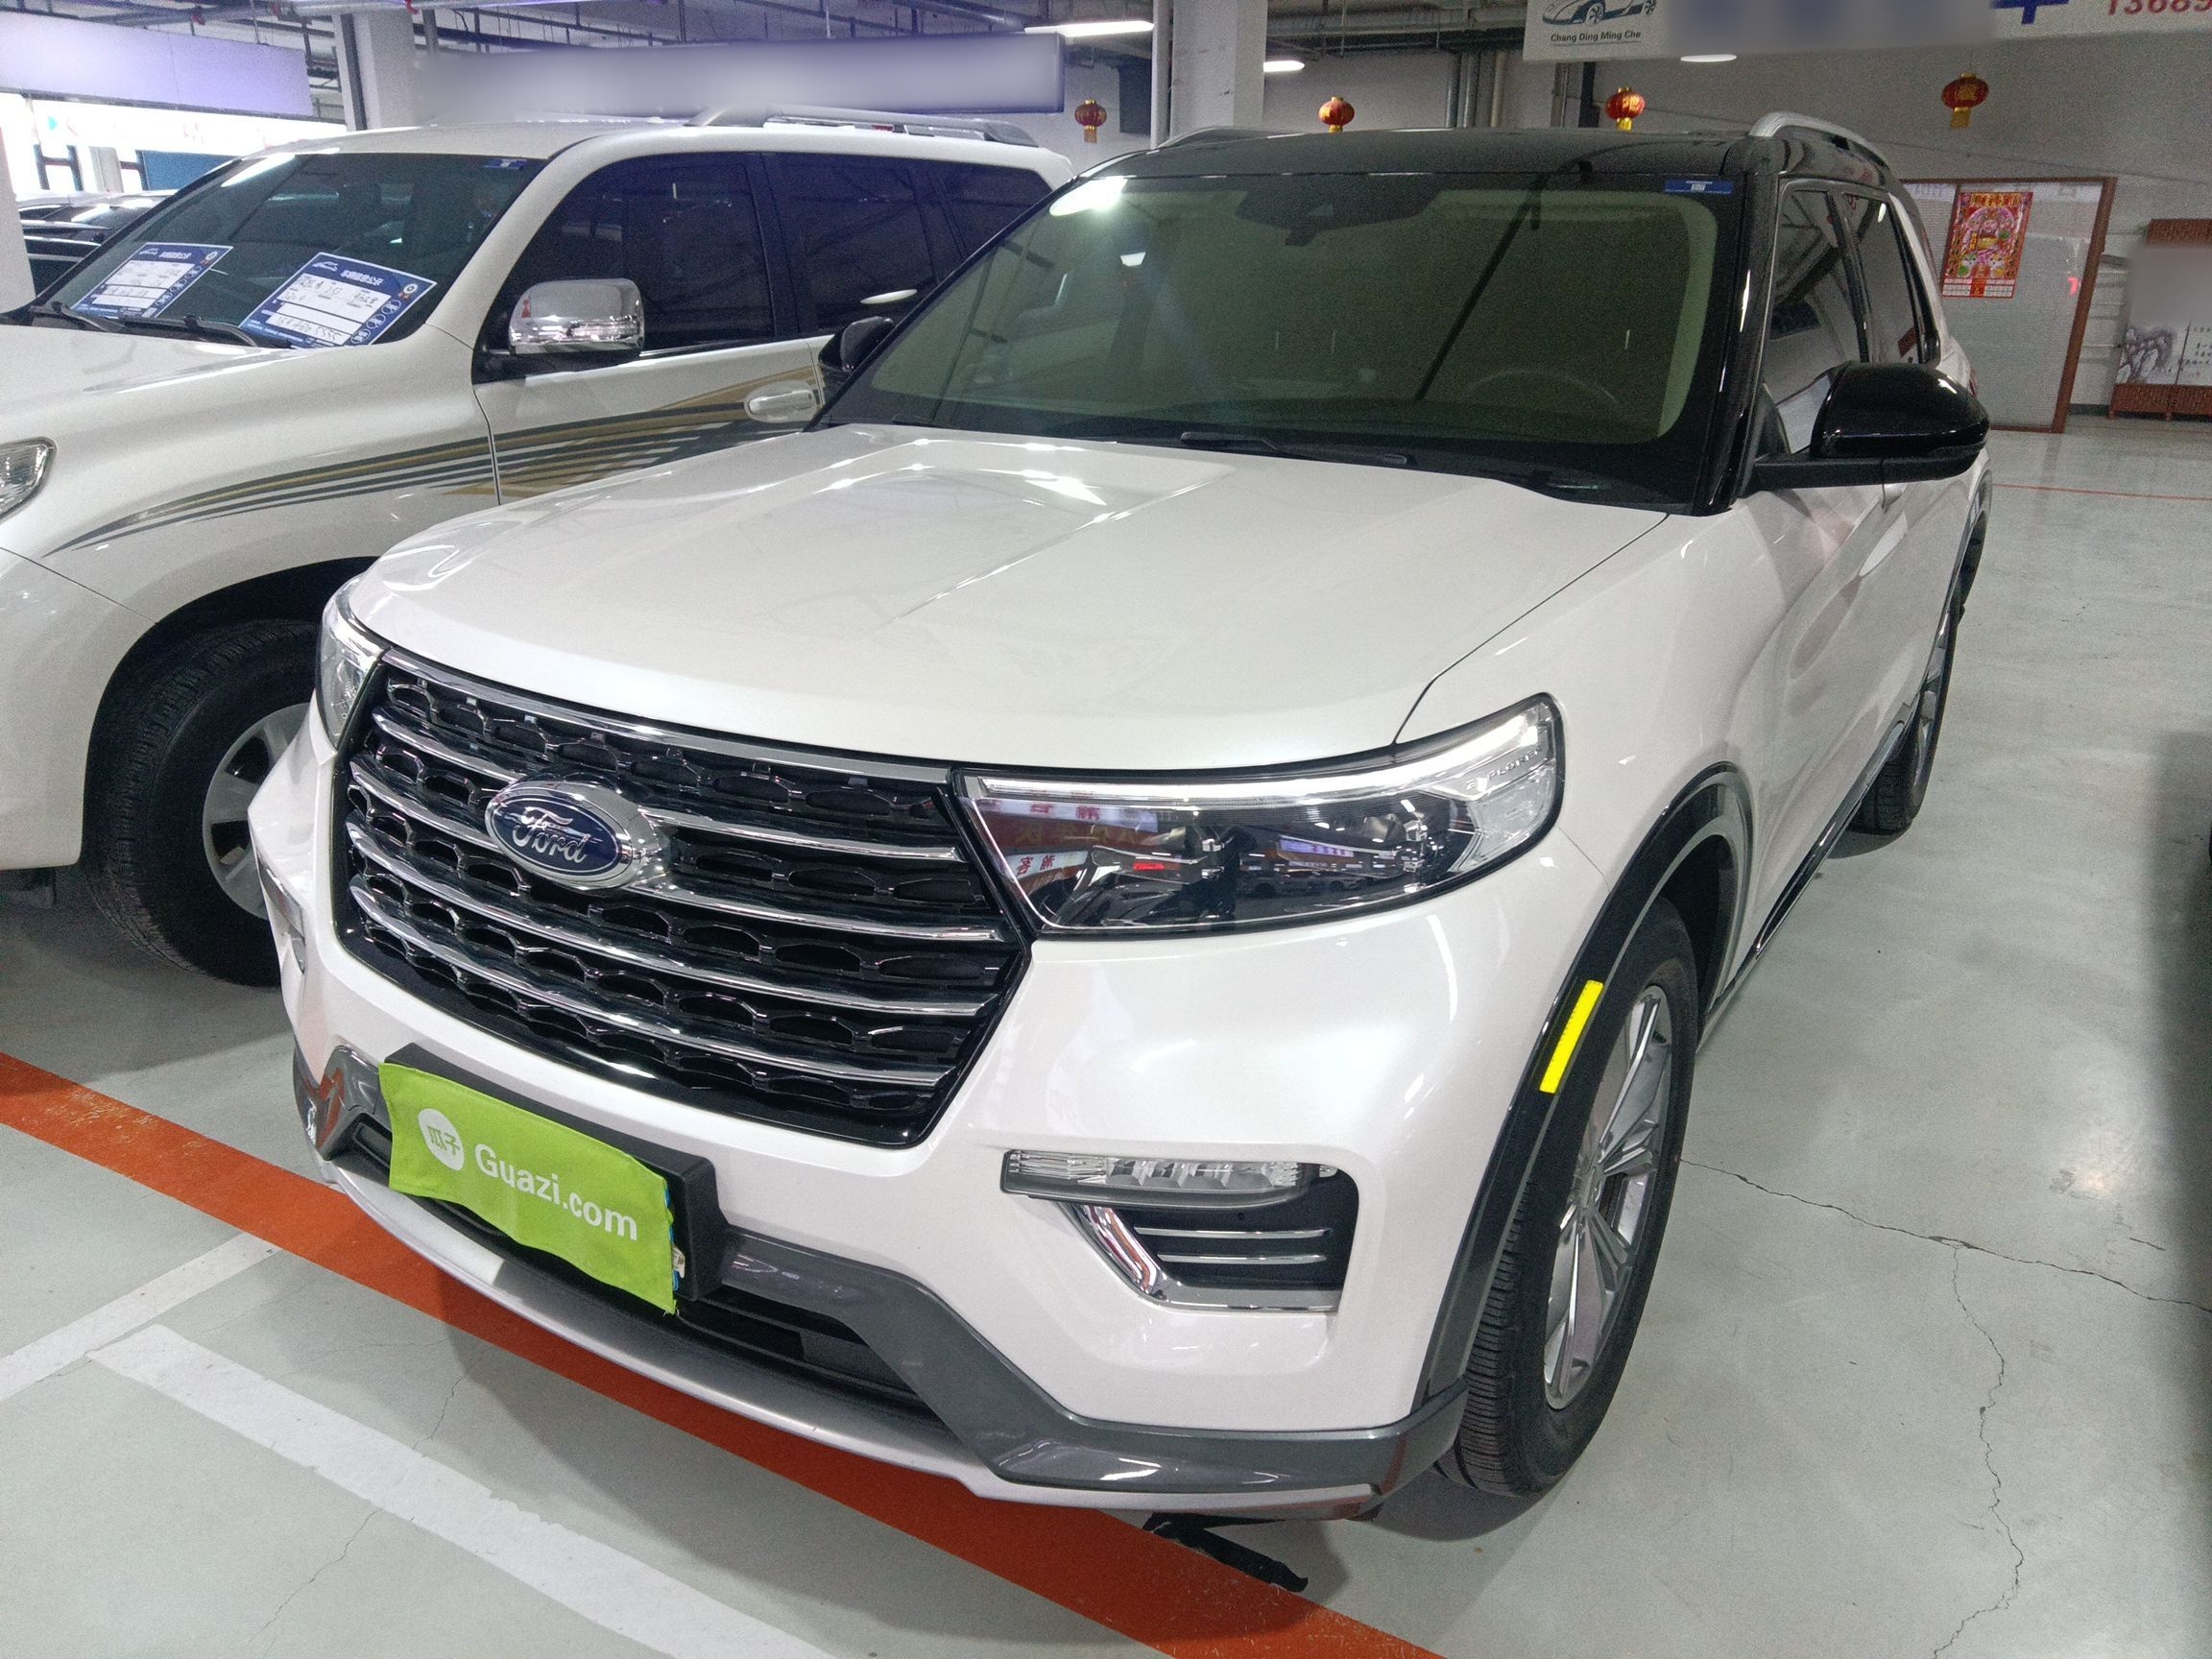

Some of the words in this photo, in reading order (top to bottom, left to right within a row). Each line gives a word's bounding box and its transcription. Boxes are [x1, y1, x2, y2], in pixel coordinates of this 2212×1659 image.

[1551, 33, 1576, 43] Chang
[1578, 33, 1599, 42] Ding
[1600, 31, 1623, 41] Ming
[1624, 30, 1641, 39] Che
[1466, 746, 1541, 791] EPLORER
[510, 805, 592, 864] Ford
[429, 1125, 461, 1158] 瓜子
[475, 1142, 637, 1241] Guazi.com
